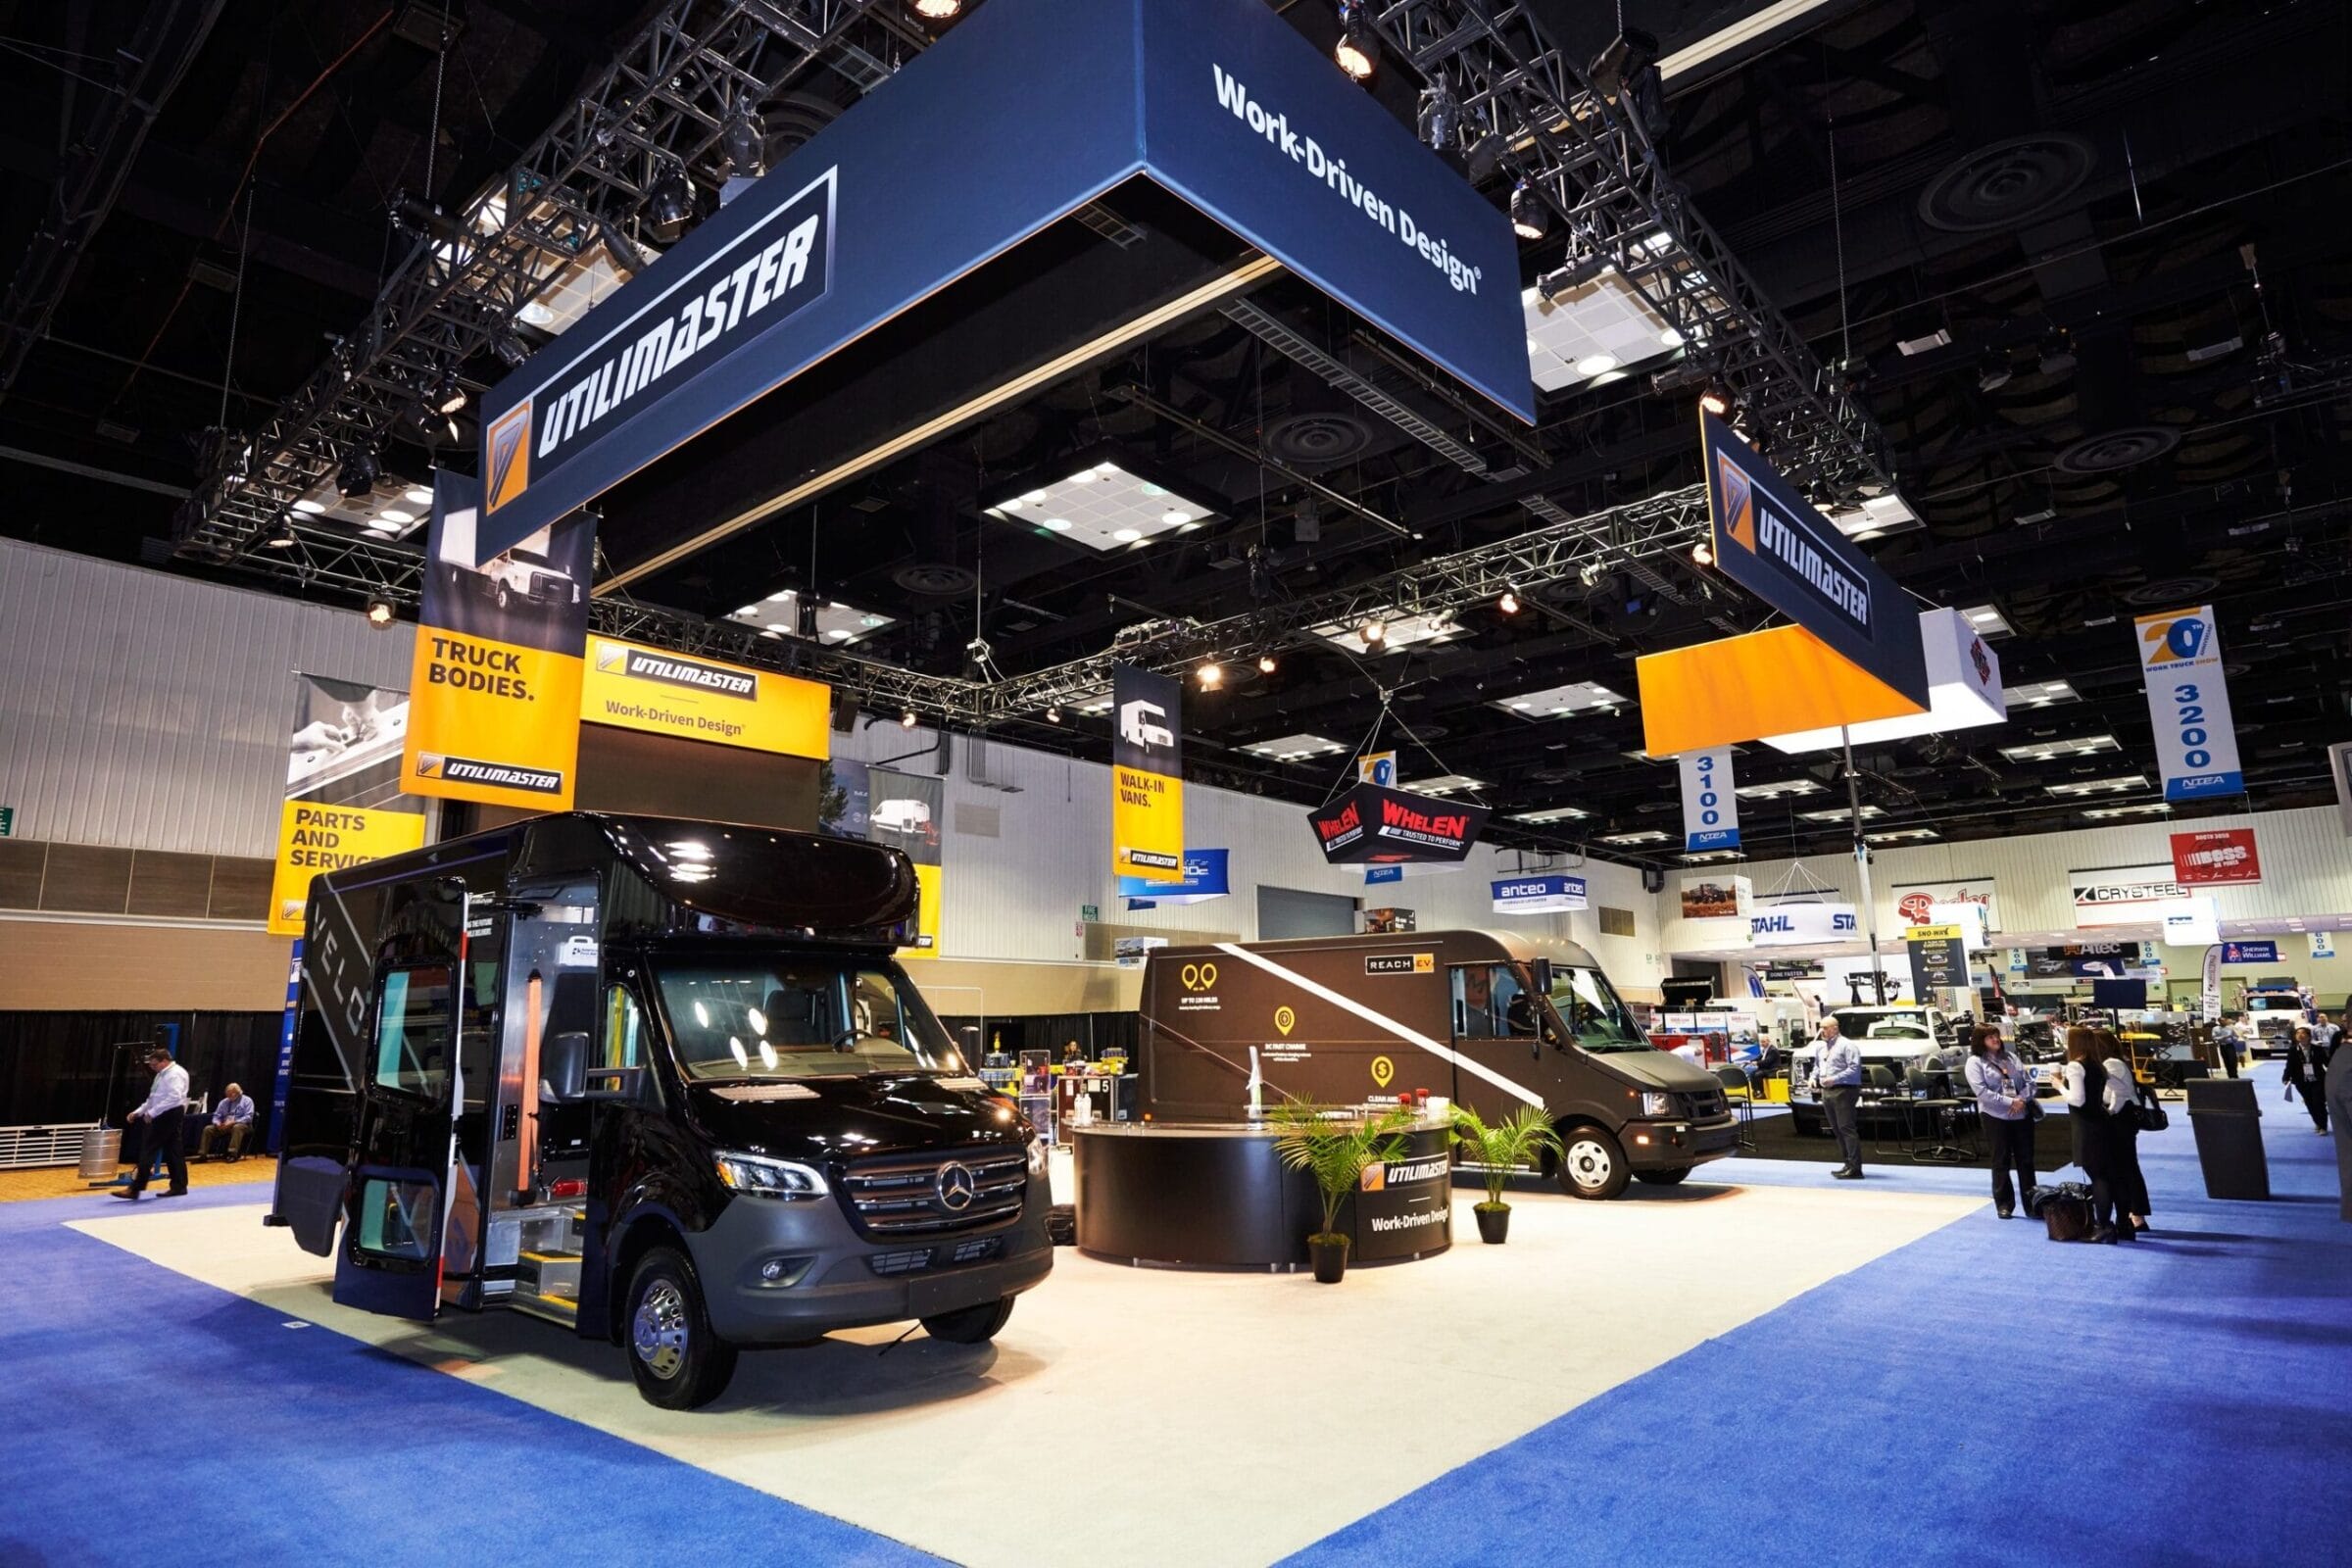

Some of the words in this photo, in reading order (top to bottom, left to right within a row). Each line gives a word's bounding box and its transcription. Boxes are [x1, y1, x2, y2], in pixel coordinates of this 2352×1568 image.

[1212, 62, 1396, 234] Work-Driven
[537, 213, 819, 460] UTILIMASTER
[1759, 507, 1868, 626] UTILIMASTER
[430, 637, 521, 674] TRUCK
[2171, 661, 2195, 669] TRUCK
[2195, 657, 2219, 665] SHOW
[428, 664, 536, 703] BODIES.
[630, 655, 755, 695] UTILIMASTER
[606, 700, 695, 727] Work-Driven
[447, 762, 560, 789] UTILIMASTER
[1120, 772, 1165, 795] WALK-IN
[2182, 775, 2225, 789] NTEA
[1120, 788, 1152, 808] VANS.
[295, 808, 366, 831] PARTS
[1317, 801, 1360, 841] WHELEN
[1383, 799, 1467, 840] WHELEN
[291, 829, 339, 849] AND
[1402, 829, 1428, 842] TRUSTED
[289, 849, 380, 869] SERVIC
[1500, 883, 1546, 898] anteo
[1563, 882, 1584, 894] anteo
[2097, 883, 2187, 901] CRYSTEEL
[1370, 960, 1411, 969] REACH
[1372, 1211, 1431, 1232] Work-Driven
